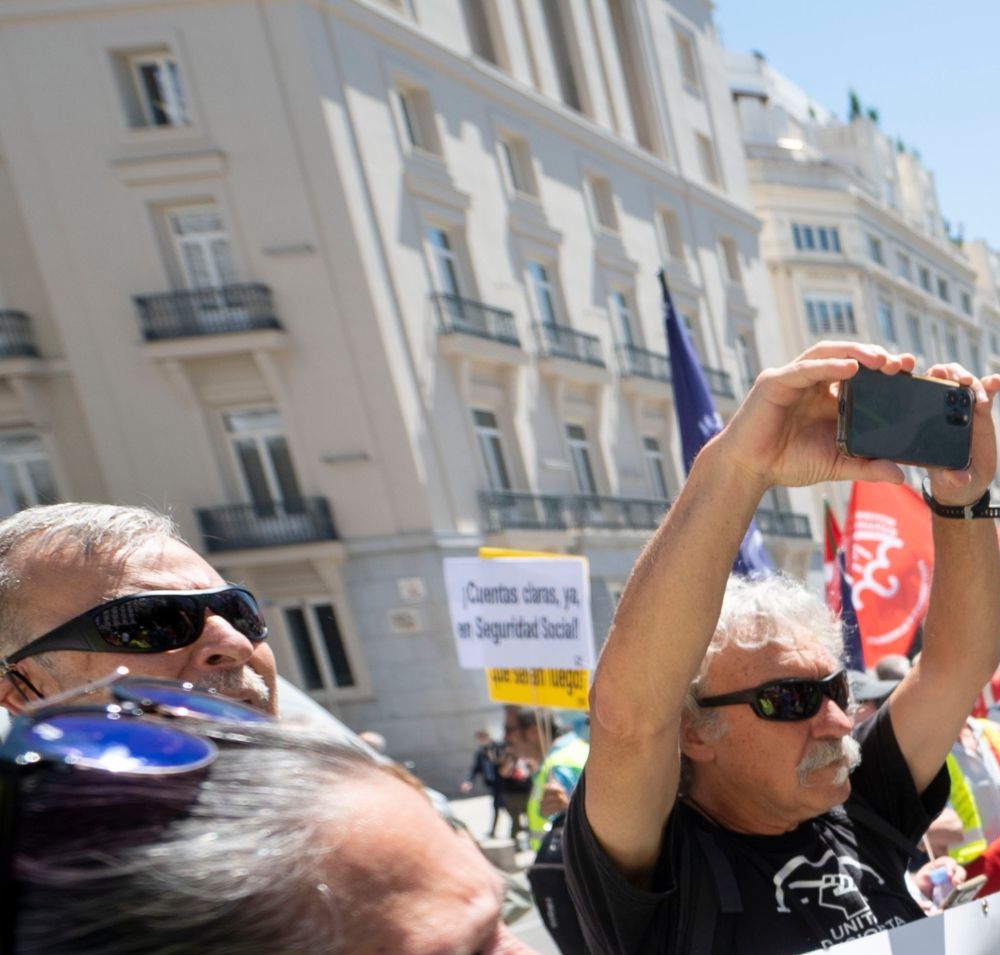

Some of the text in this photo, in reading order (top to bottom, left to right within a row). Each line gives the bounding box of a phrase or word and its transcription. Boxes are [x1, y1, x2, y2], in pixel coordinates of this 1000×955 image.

[462, 580, 518, 610] ¡Cuentas
[521, 582, 560, 606] claras,
[457, 616, 579, 645] en Seguridad Social!
